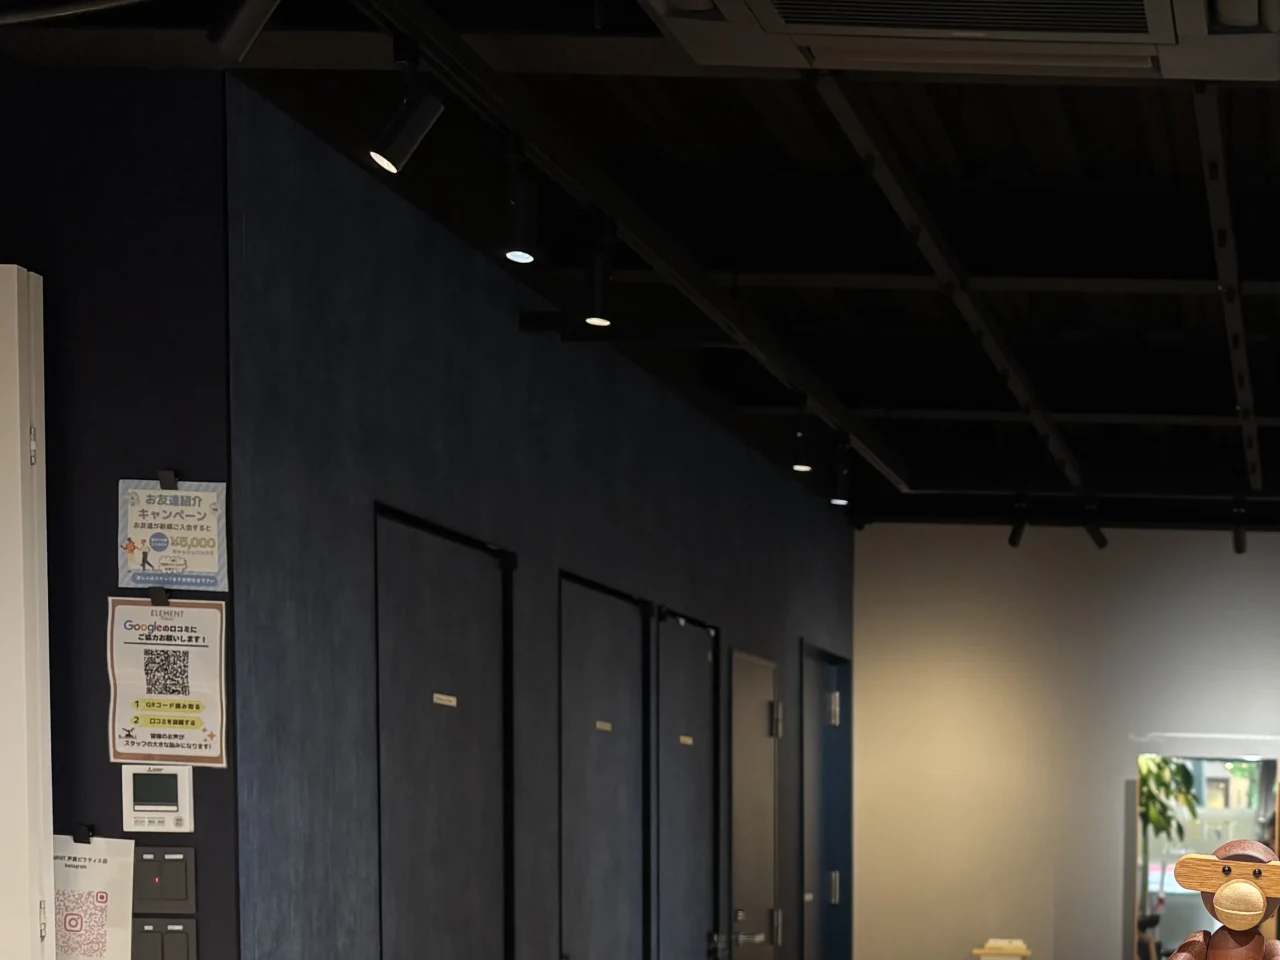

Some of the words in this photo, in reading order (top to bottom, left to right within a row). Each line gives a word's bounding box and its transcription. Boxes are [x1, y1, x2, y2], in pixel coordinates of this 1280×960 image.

[145, 494, 202, 507] お友達紹介
[138, 509, 207, 521] キャンペーン
[151, 609, 184, 618] ELEMENT
[124, 620, 197, 634] Googleの口コミに
